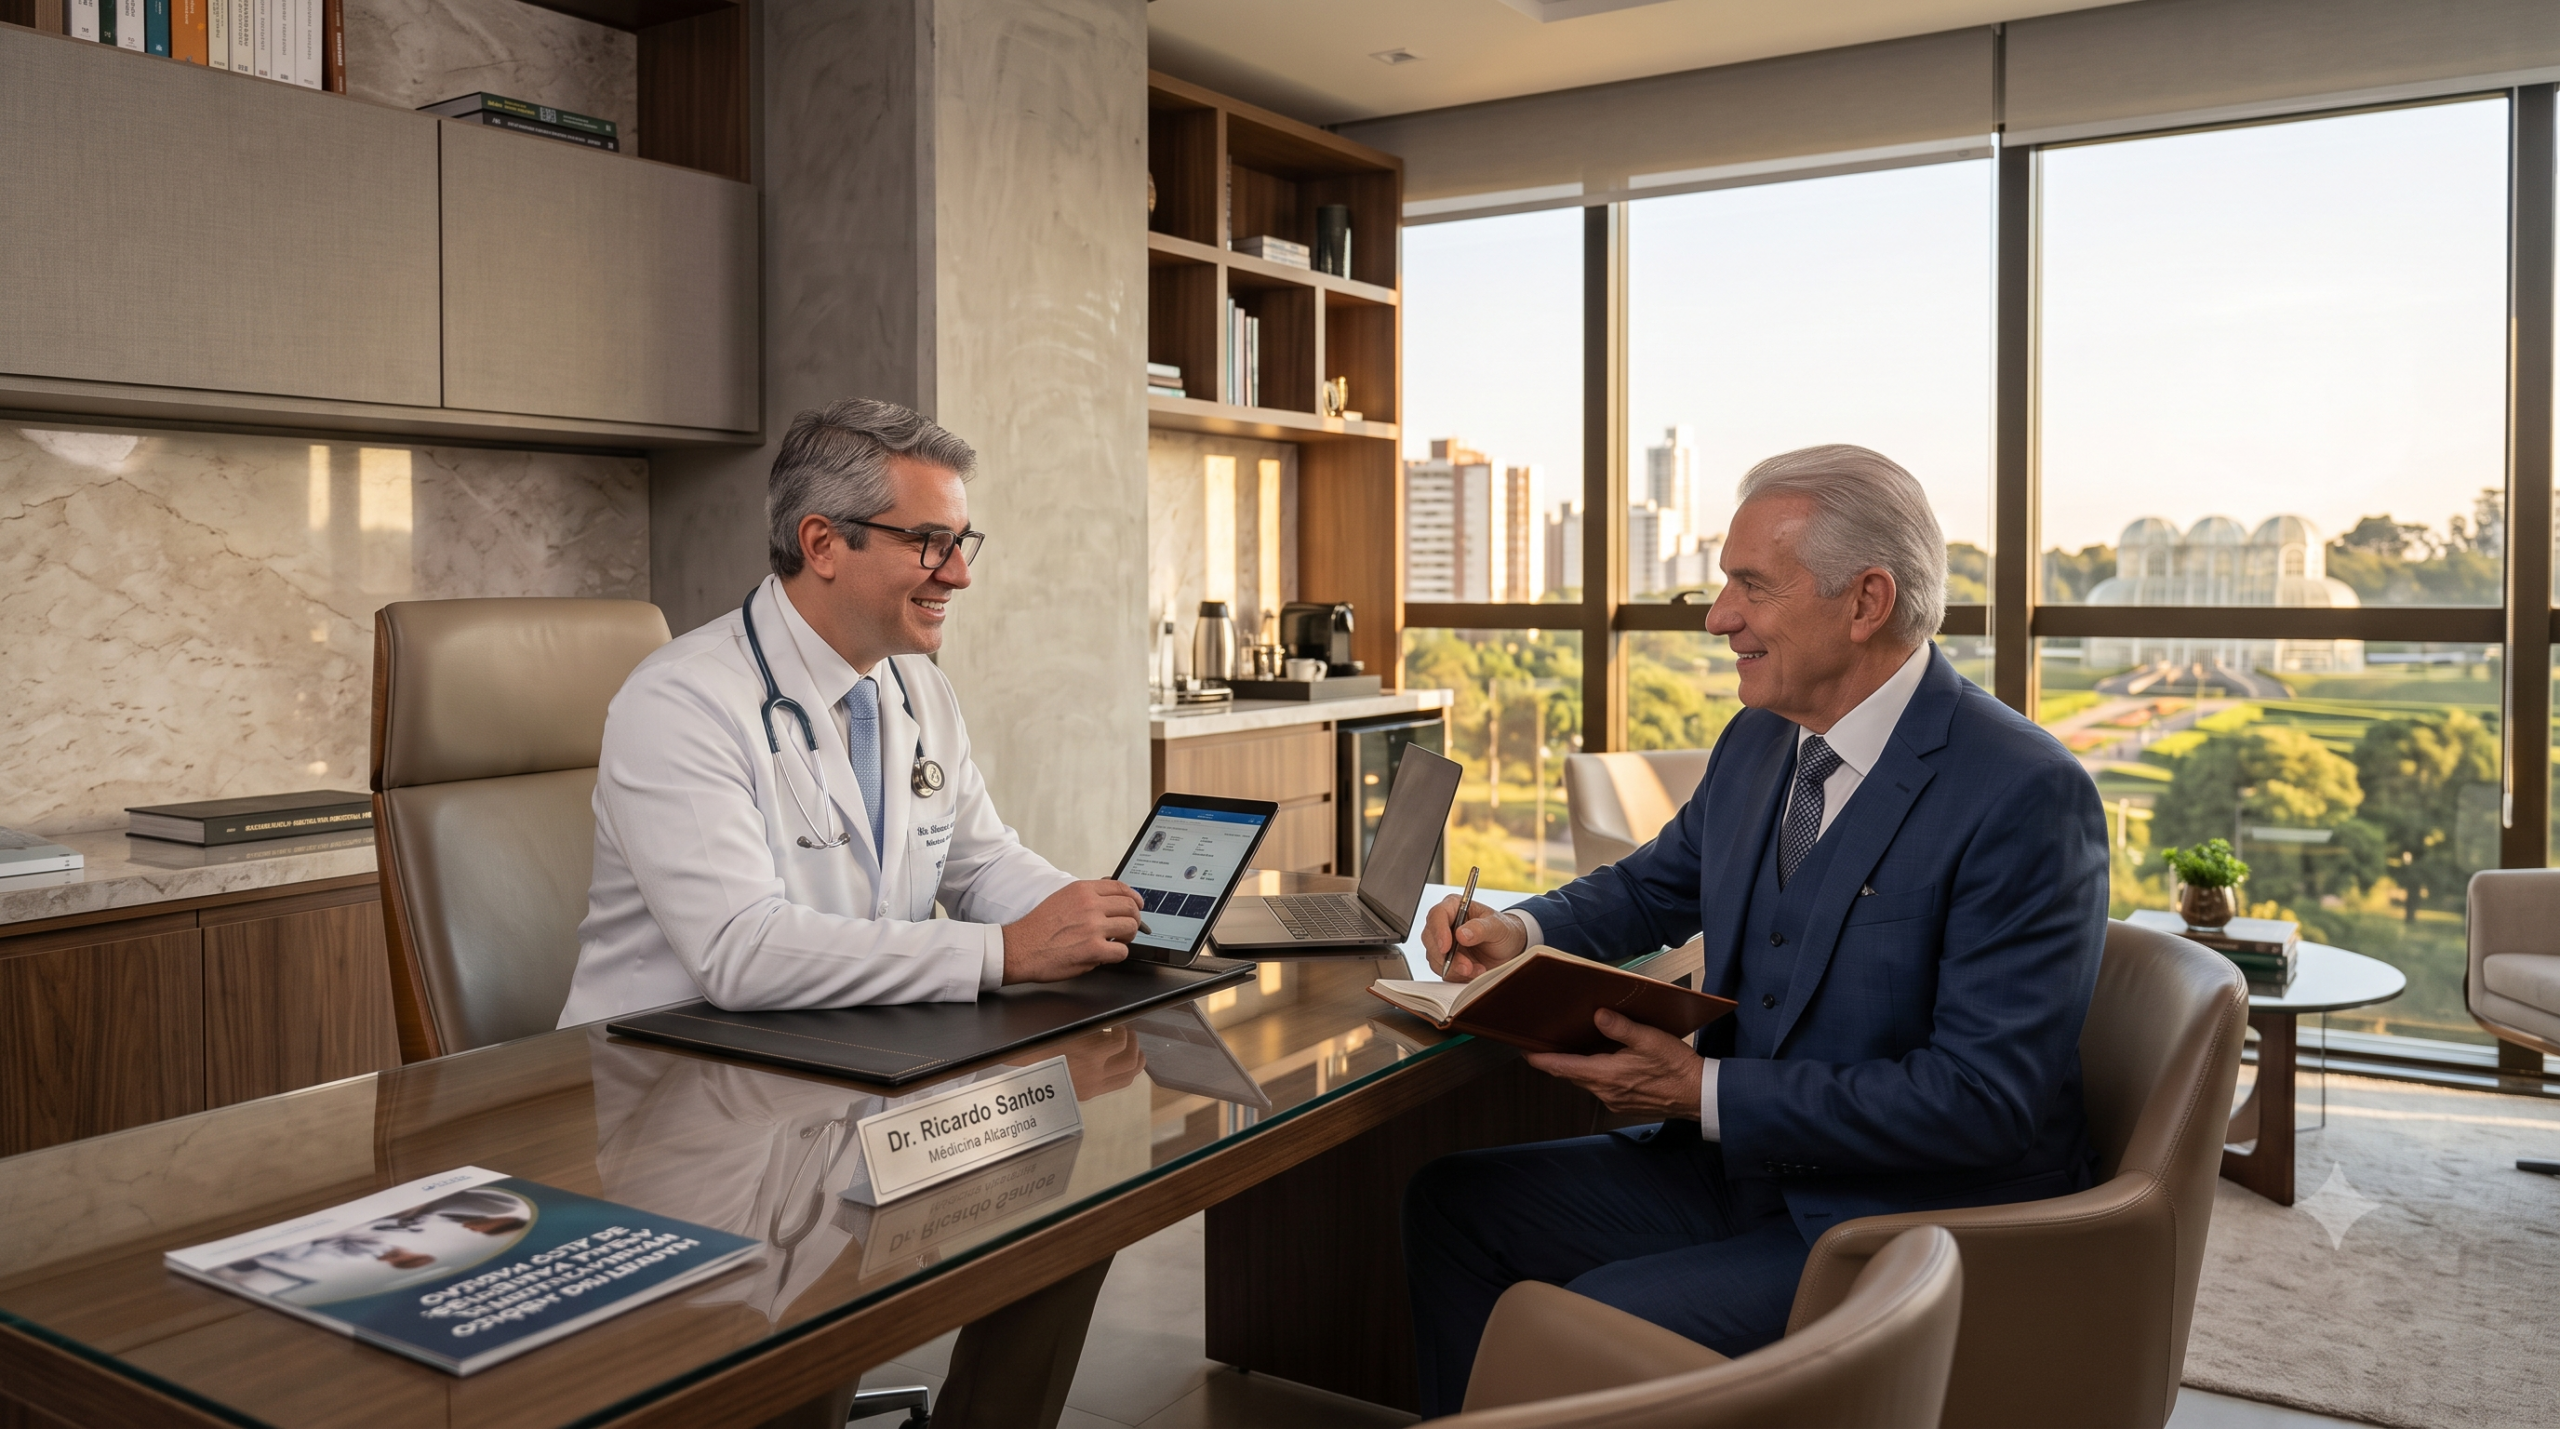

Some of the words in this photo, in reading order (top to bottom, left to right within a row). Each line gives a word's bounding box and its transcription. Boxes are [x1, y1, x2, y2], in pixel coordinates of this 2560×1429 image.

[887, 1130, 917, 1152] Dr.
[920, 1103, 991, 1141] Ricardo
[995, 1084, 1055, 1115] Santos
